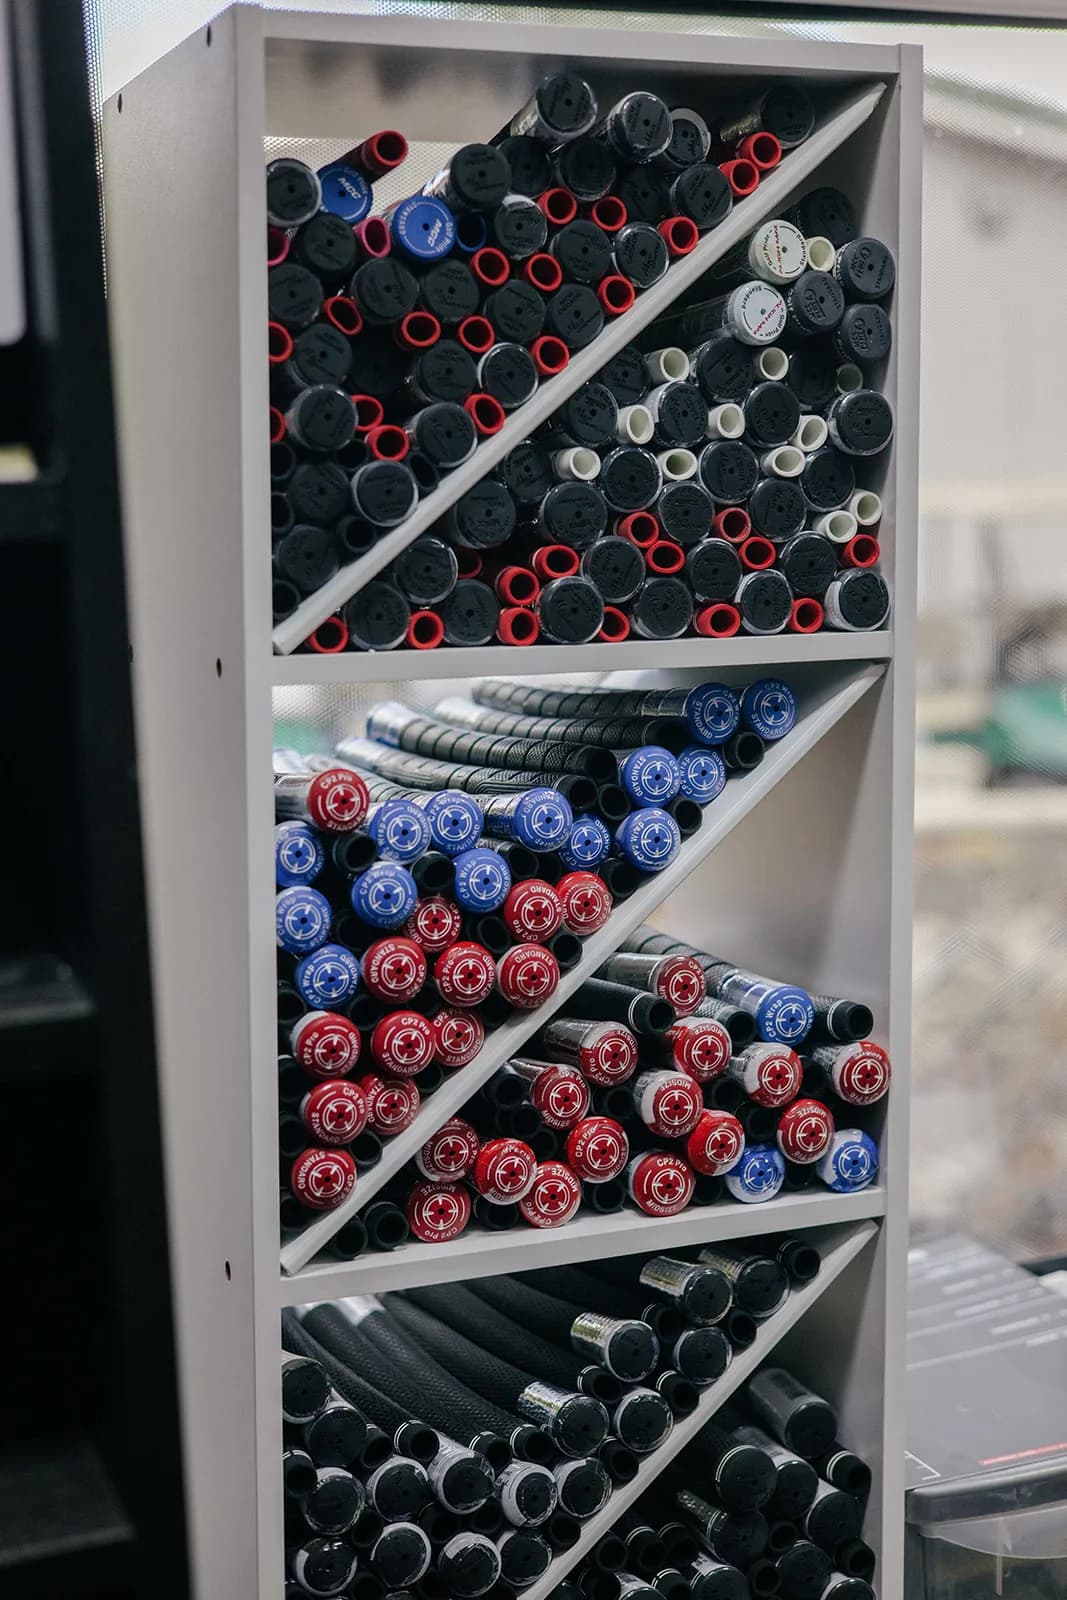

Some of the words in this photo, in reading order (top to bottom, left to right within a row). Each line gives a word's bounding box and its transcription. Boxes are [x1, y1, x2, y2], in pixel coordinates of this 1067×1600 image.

[337, 177, 361, 199] MCC
[427, 218, 442, 247] MCC
[762, 234, 770, 250] Pride
[796, 234, 806, 264] Standard
[740, 285, 762, 310] Standard
[764, 326, 778, 336] Pride
[775, 314, 785, 330] Golf
[693, 699, 713, 739] STANDARD
[750, 713, 784, 734] STANDARD
[667, 758, 680, 776] CP2
[678, 755, 691, 776] Wrap
[319, 773, 336, 789] CP2
[631, 754, 647, 797] STANDARD
[679, 779, 693, 795] CP2
[326, 810, 366, 830] STANDARD
[428, 802, 441, 821] CP2
[377, 821, 387, 846] Wrap
[406, 805, 430, 844] STANDARD
[630, 819, 645, 841] Wrap
[446, 824, 481, 851] STANDARD
[593, 818, 611, 859] STANDARD
[631, 844, 645, 861] CP2
[459, 858, 477, 878] Wrap
[360, 876, 374, 894] CP2
[459, 881, 470, 899] CP2
[492, 862, 511, 905] STANDARD
[529, 885, 563, 912] STANDARD
[448, 901, 460, 919] CP2
[309, 904, 330, 947] STANDARD
[450, 922, 461, 937] Pro
[511, 918, 523, 934] Pro
[521, 930, 537, 941] CP2
[371, 942, 395, 983] STANDARD
[442, 958, 455, 973] Pro
[513, 949, 554, 966] STANDARD
[303, 963, 315, 986] Wrap
[339, 953, 357, 995] STANDARD
[415, 964, 424, 983] CP2
[479, 953, 495, 997] STANDARD
[688, 960, 702, 975] CP2
[442, 975, 453, 993] CP2
[306, 988, 322, 1004] CP2
[766, 998, 783, 1018] Wrap
[400, 1017, 418, 1026] CP2
[418, 1020, 431, 1036] Pro
[433, 1011, 448, 1027] CP2
[305, 1030, 320, 1045] Pro
[766, 1021, 776, 1038] CP2
[304, 1046, 313, 1065] CP2
[339, 1031, 359, 1074] STANDARD
[445, 1038, 481, 1063] STANDARD
[382, 1051, 418, 1073] STANDARD
[588, 1057, 598, 1072] Pro
[575, 1073, 587, 1089] Pro
[658, 1079, 692, 1092] MIDSIZE
[342, 1087, 358, 1101] CP2
[355, 1097, 365, 1113] Pro
[365, 1080, 384, 1123] STANDARD
[312, 1111, 339, 1144] STANDARD
[465, 1129, 478, 1148] CP2
[575, 1138, 585, 1157] CP2
[467, 1149, 478, 1165] Pro
[656, 1158, 674, 1167] CP2
[674, 1158, 687, 1173] Pro
[298, 1150, 325, 1189] STANDARD
[343, 1173, 353, 1192] CP2
[551, 1168, 578, 1192] MIDSIZE
[525, 1201, 536, 1216] Pro
[532, 1213, 551, 1225] CP2
[423, 1228, 438, 1239] Pro
[441, 1225, 458, 1239] CP2
